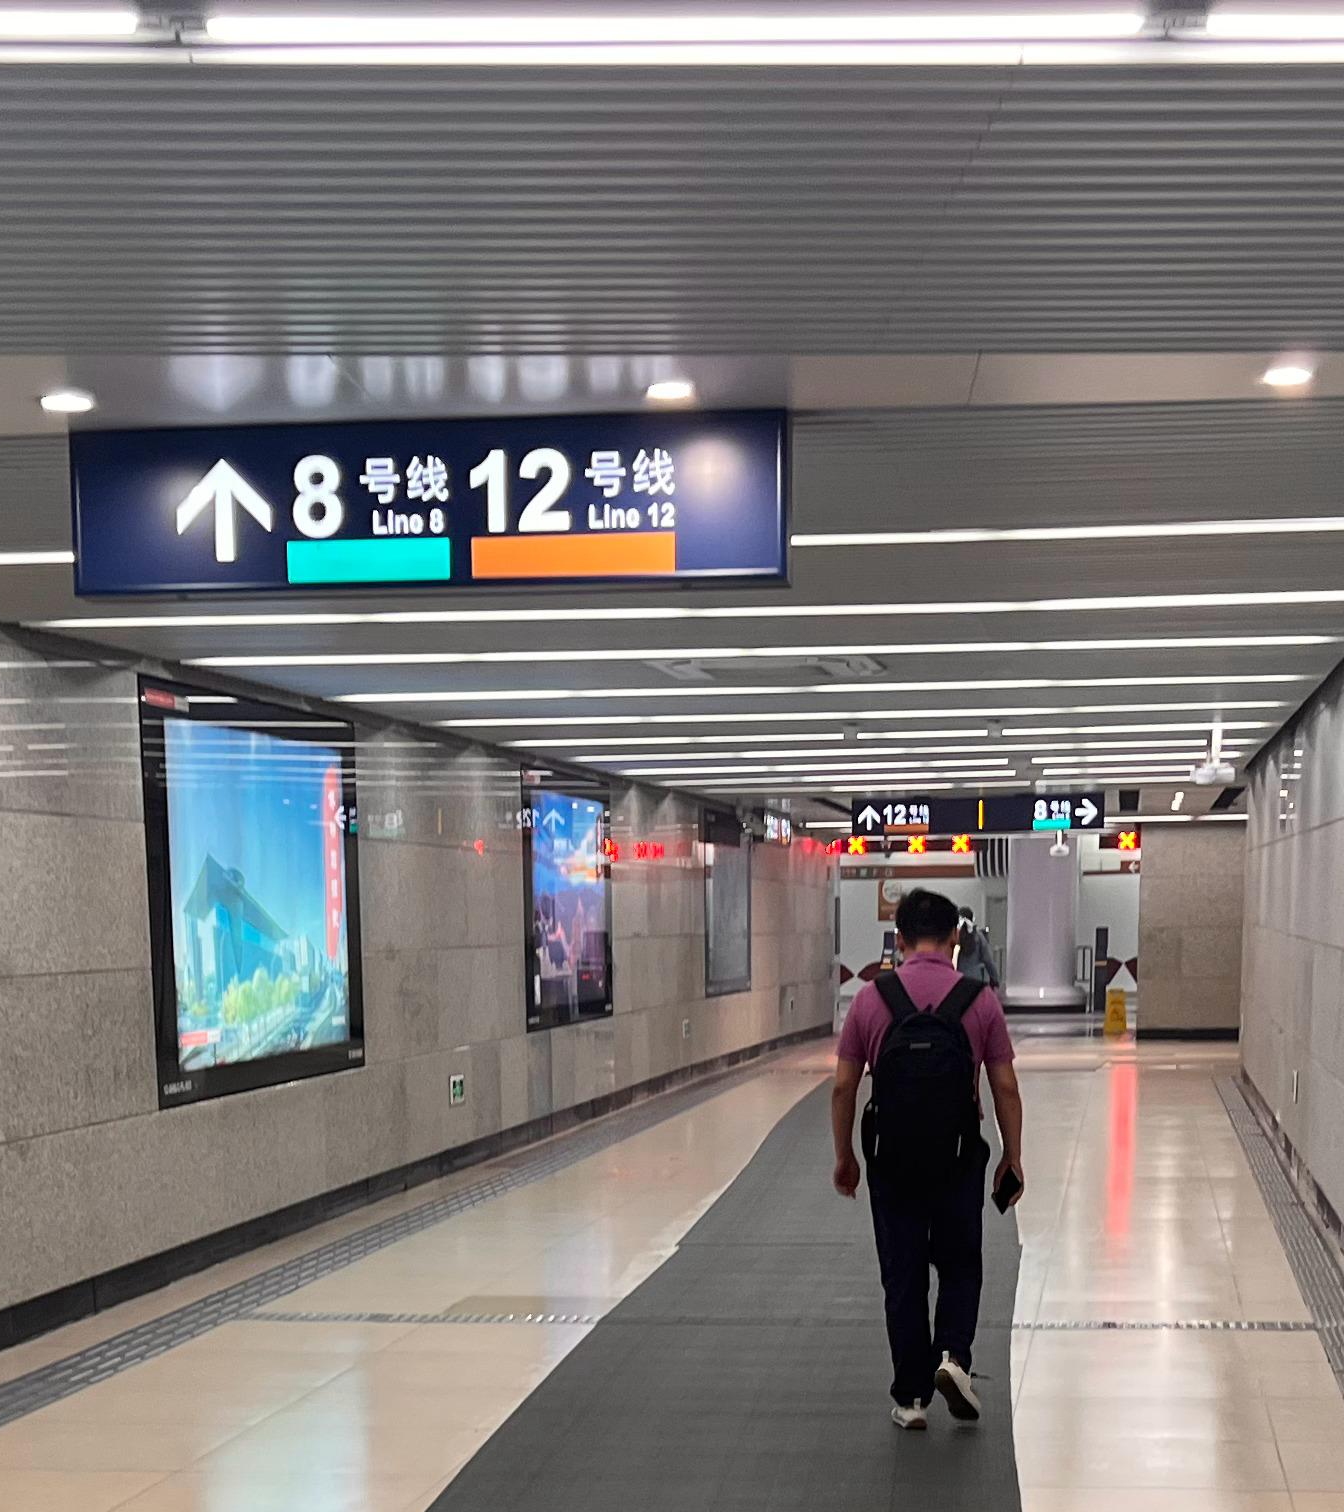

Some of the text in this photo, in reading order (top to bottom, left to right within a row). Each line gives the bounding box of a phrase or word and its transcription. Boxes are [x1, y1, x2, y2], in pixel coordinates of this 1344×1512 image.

[292, 447, 676, 539] 8 号线 12 号线
[372, 508, 445, 535] Line 8
[588, 502, 676, 530] Line 12
[882, 804, 907, 826] 12
[1034, 799, 1047, 820] 8
